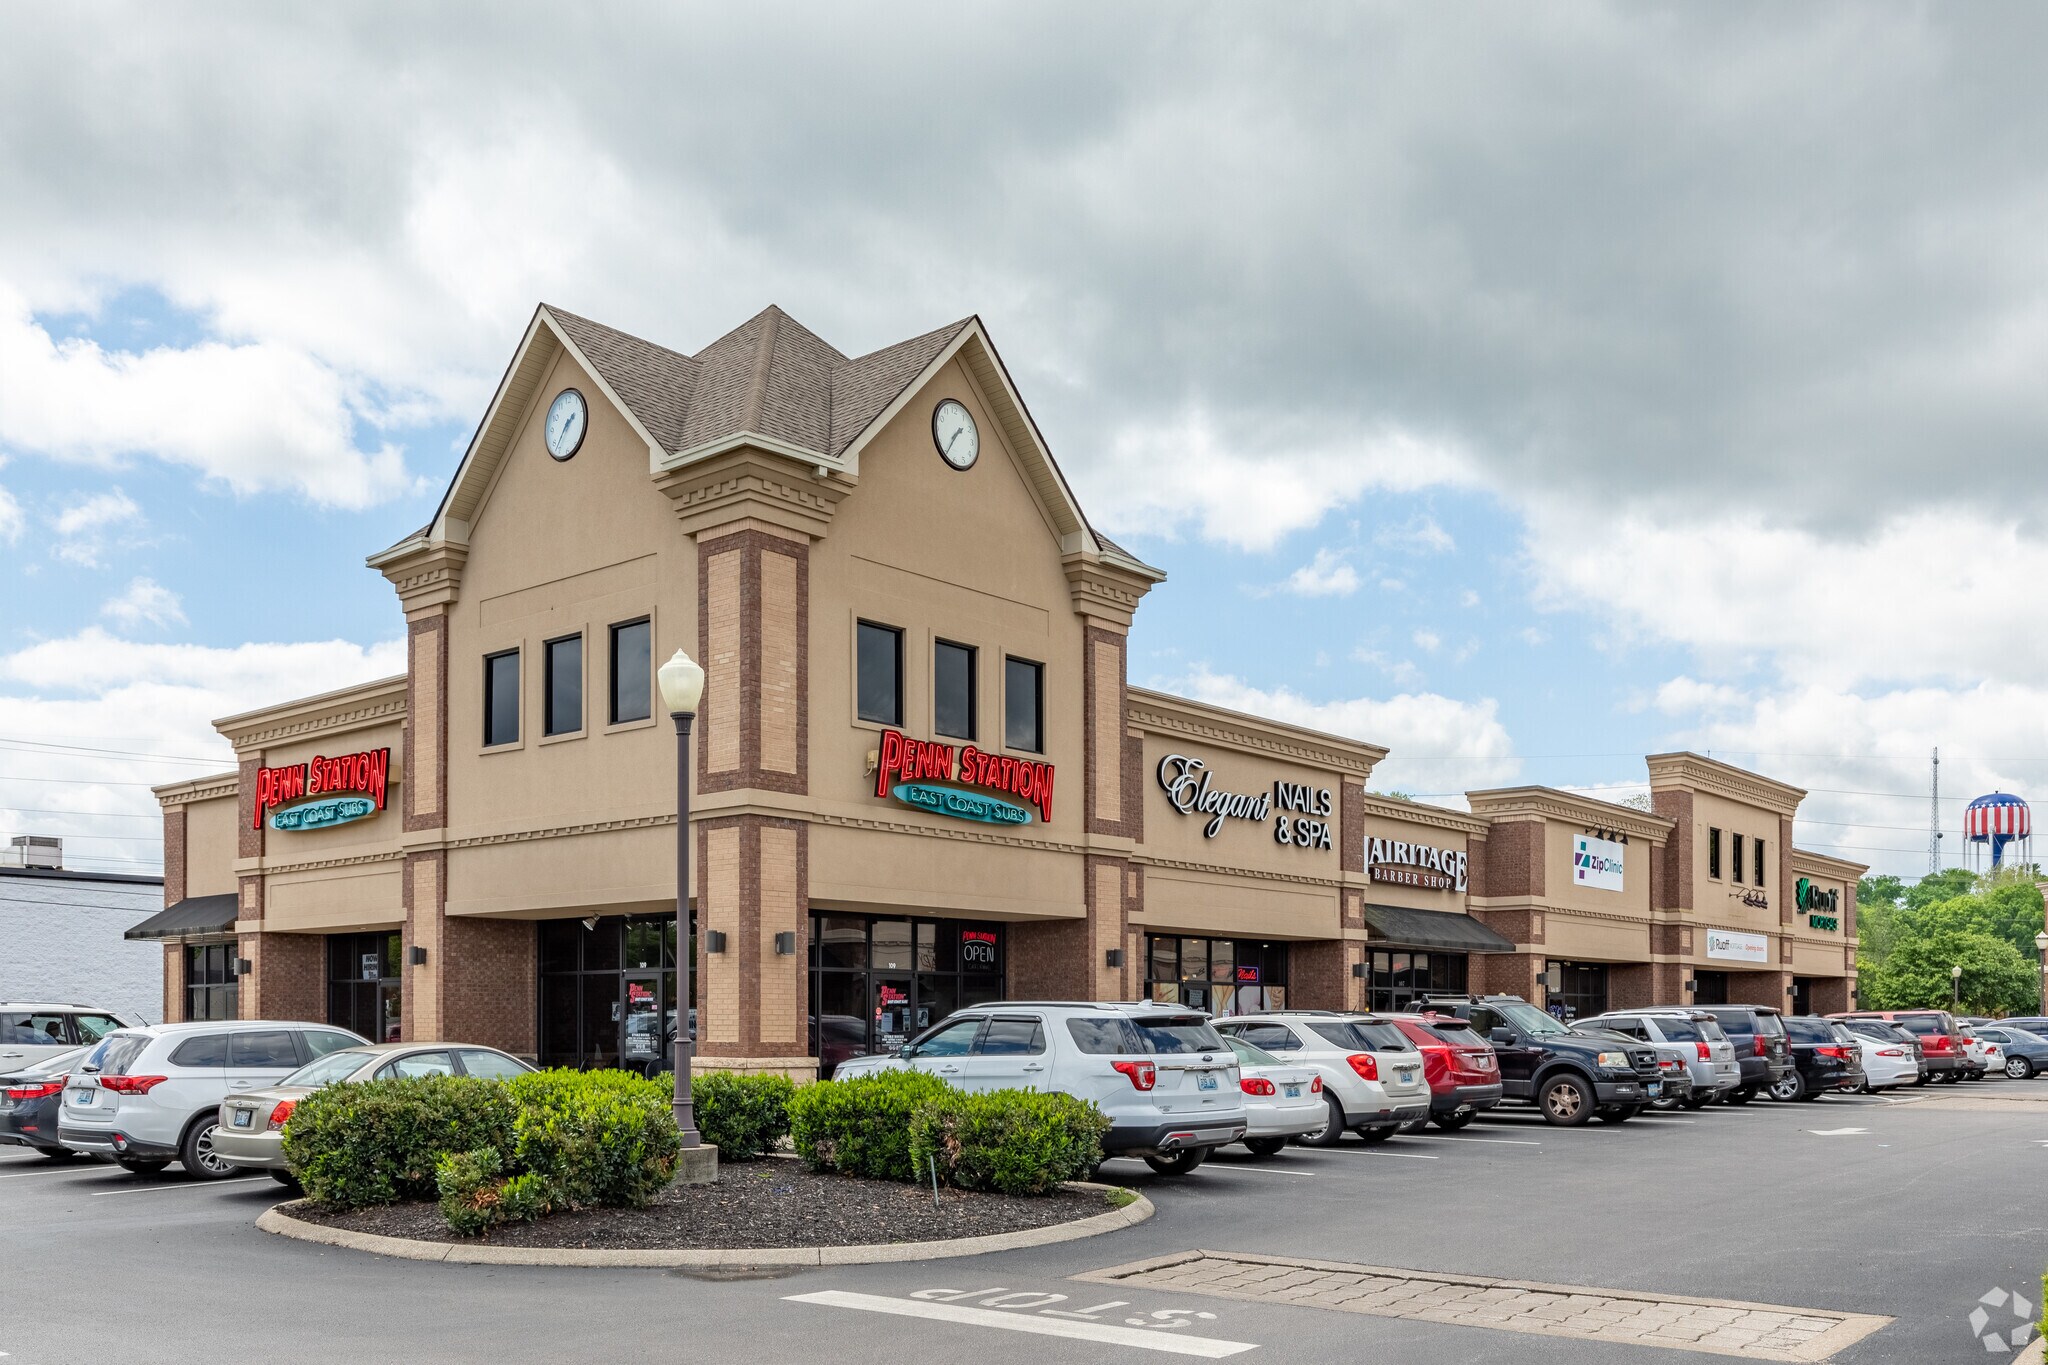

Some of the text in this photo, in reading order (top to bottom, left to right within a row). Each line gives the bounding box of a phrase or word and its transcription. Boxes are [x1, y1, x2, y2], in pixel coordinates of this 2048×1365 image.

[876, 729, 1055, 823] PENN STATION
[254, 747, 391, 830] PENN STATION
[1157, 754, 1271, 839] Elegant
[1274, 781, 1333, 818] NAILS
[275, 801, 365, 828] EAST COAST SUBS
[911, 786, 1025, 822] EAST COAST SUBS
[1275, 816, 1333, 850] & SPA
[1591, 855, 1623, 875] ZipClinic
[1374, 867, 1452, 889] BARBER SHOP
[1810, 885, 1839, 913] Ruoff
[963, 944, 995, 963] OPEN
[1715, 938, 1730, 950] Ruoff
[363, 963, 378, 971] HIRIN
[639, 961, 647, 969] 109
[1237, 968, 1258, 980] Nails
[881, 985, 897, 998] PENN
[882, 993, 907, 1006] STATION
[909, 1287, 1217, 1328] STOP
